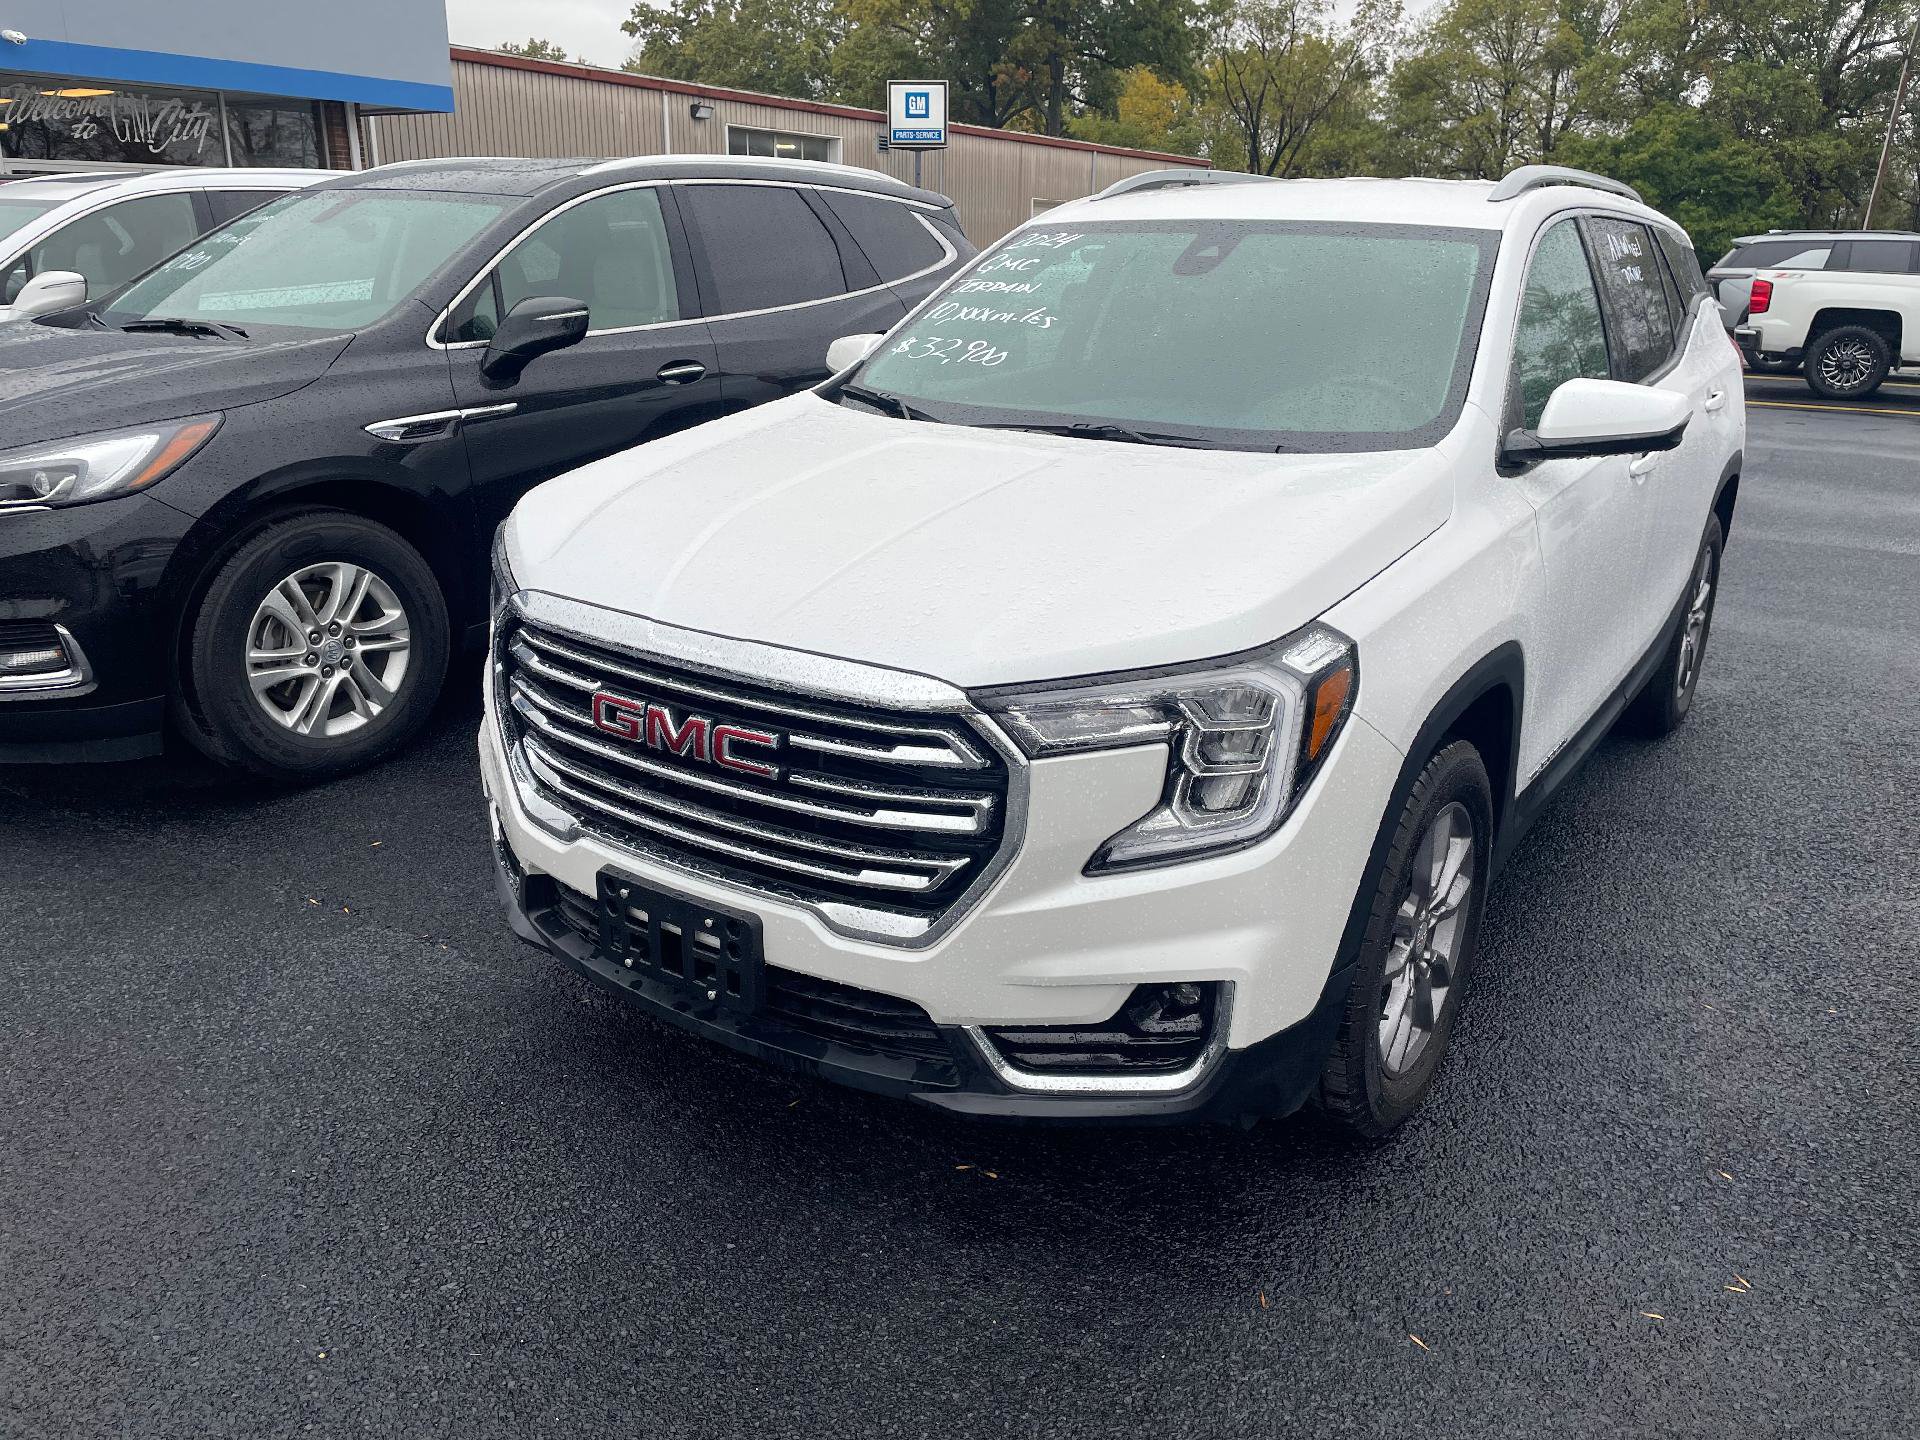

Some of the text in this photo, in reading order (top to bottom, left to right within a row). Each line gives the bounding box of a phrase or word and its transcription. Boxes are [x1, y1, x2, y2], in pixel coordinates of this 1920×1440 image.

[908, 96, 926, 110] GM
[148, 97, 212, 154] City
[977, 254, 1040, 273] GMC
[592, 690, 780, 781] GMC
